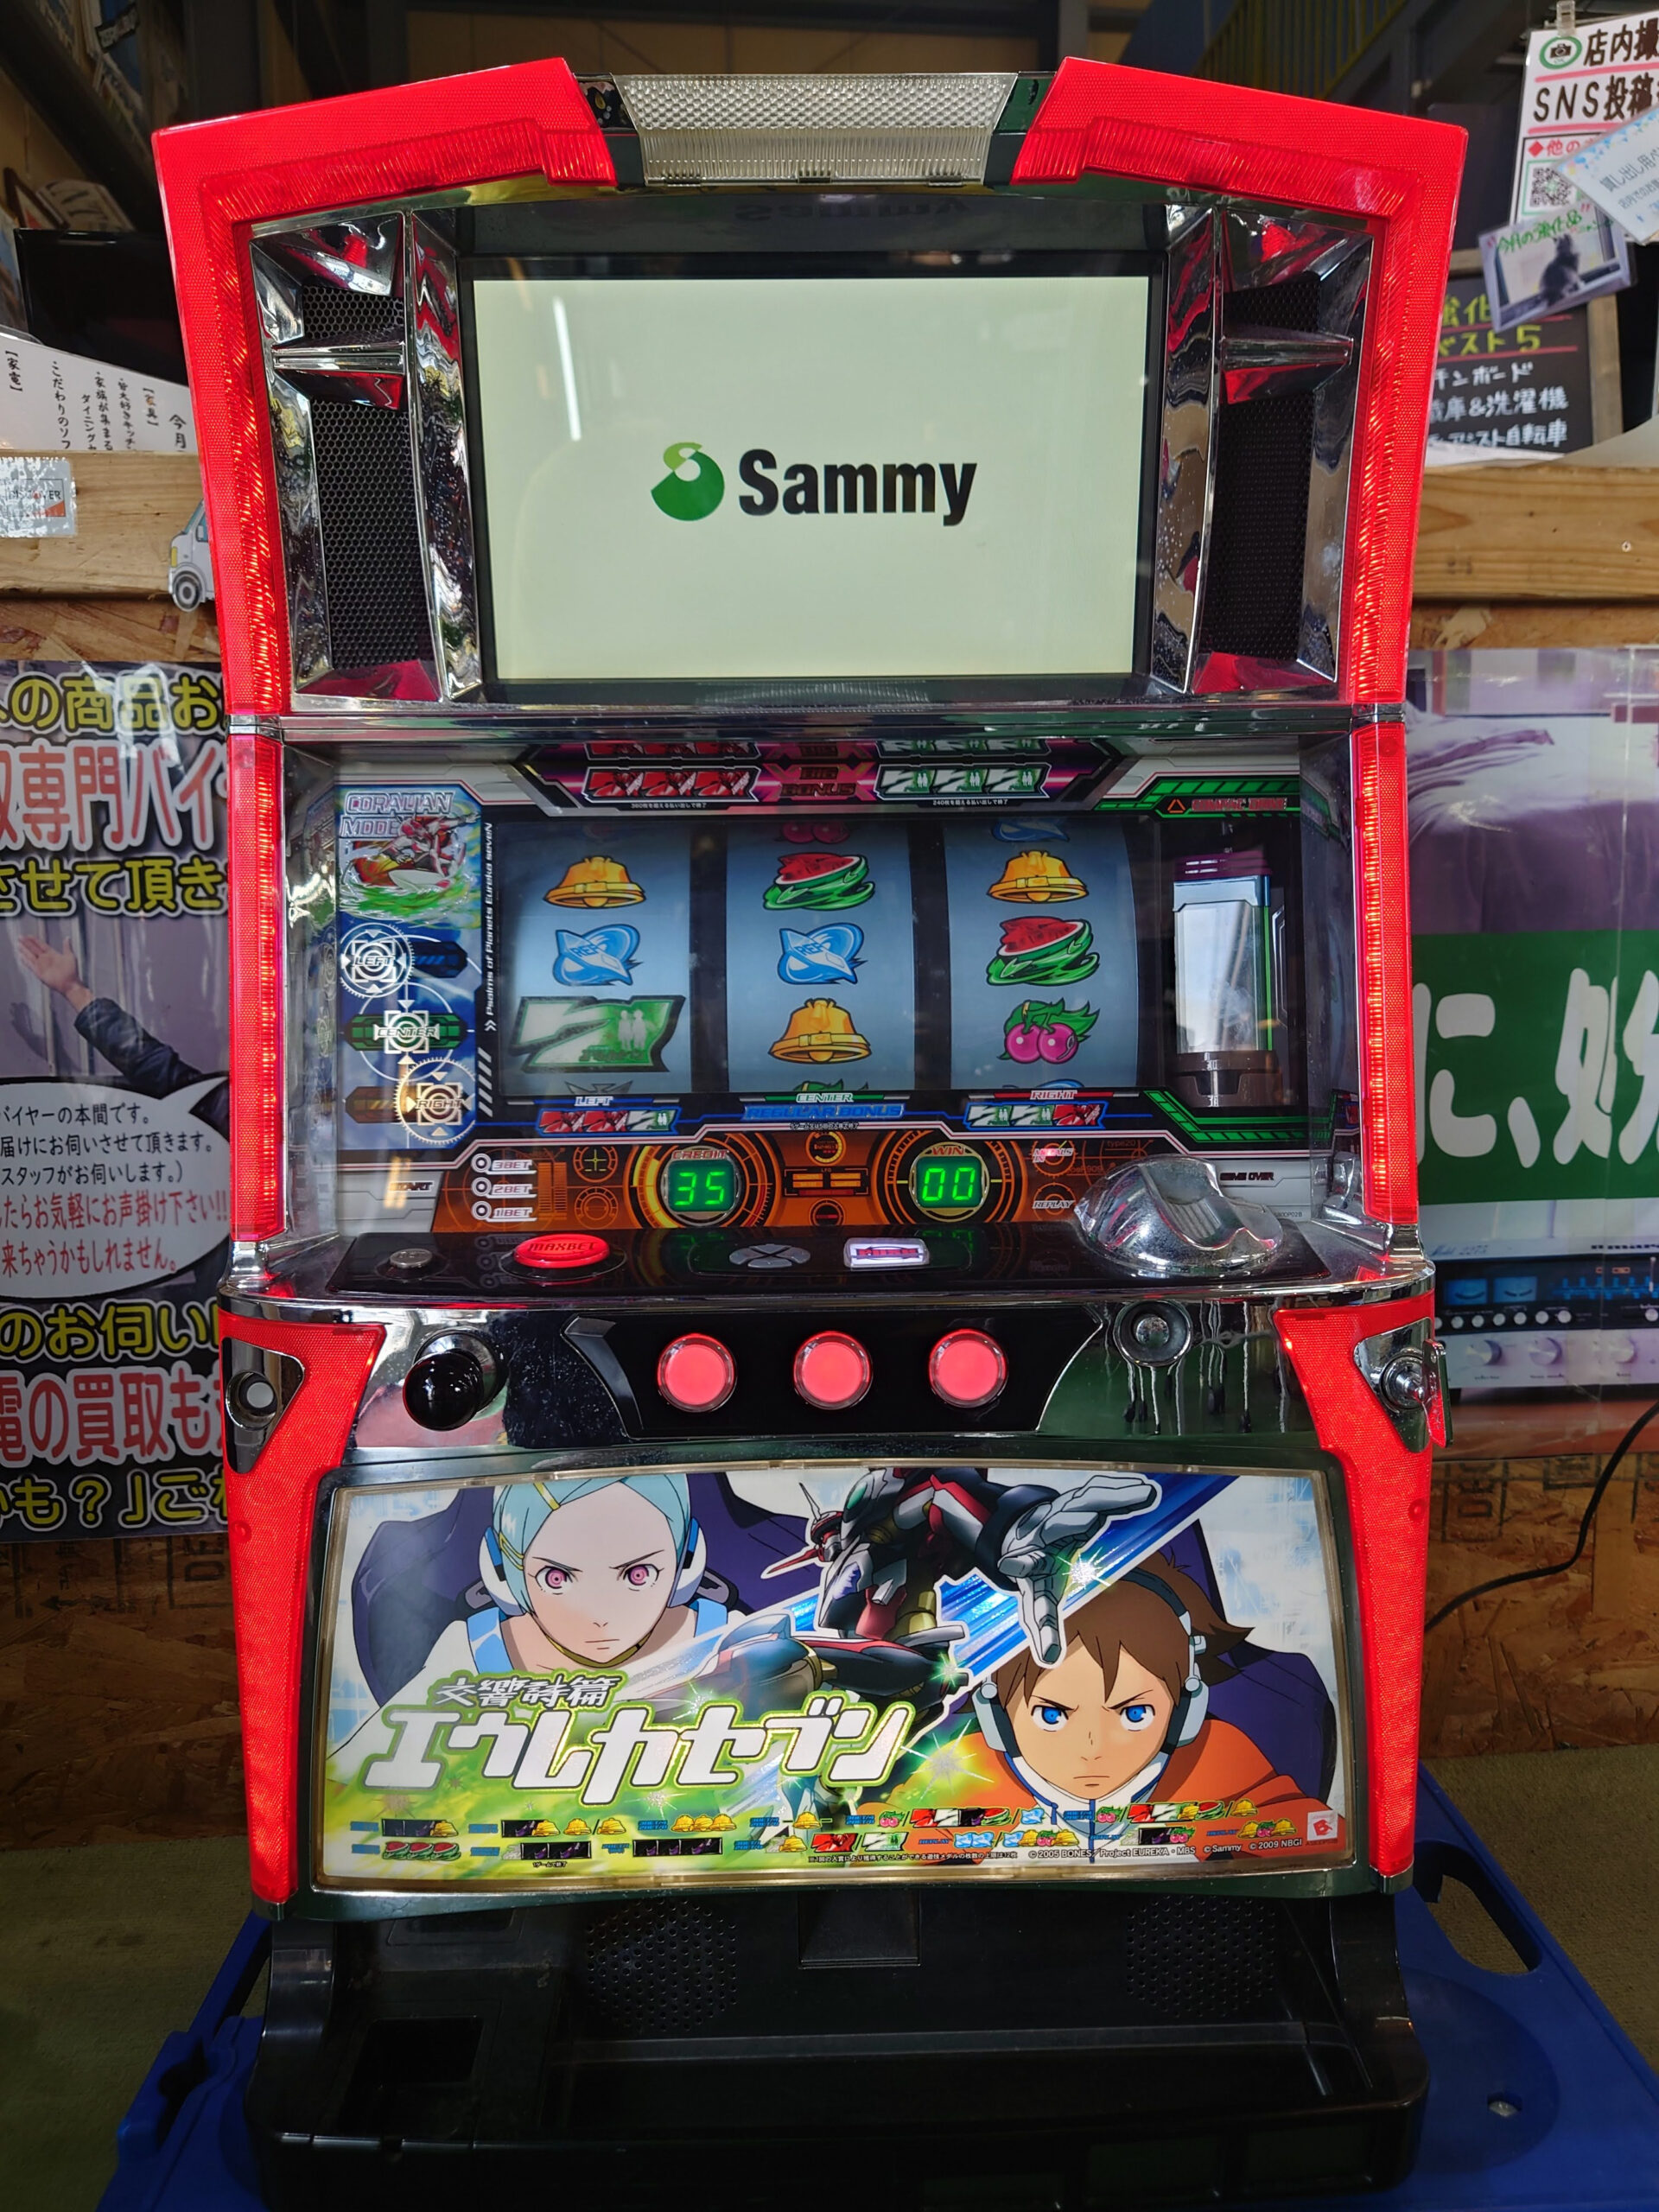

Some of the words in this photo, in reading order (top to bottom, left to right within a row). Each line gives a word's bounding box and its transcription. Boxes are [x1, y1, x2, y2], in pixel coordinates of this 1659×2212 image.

[738, 448, 977, 527] Sammy
[0, 671, 223, 732] の商品お
[0, 743, 226, 845] 専門バイ
[353, 955, 395, 967] LEFT
[377, 1027, 436, 1038] CENTER
[796, 1093, 854, 1103] CENTER
[1031, 1090, 1077, 1100] RIGHT
[416, 1098, 461, 1109] RIGHT
[575, 1096, 613, 1107] LEFT
[745, 1105, 836, 1119] REGULAR
[837, 1104, 904, 1117] BONUS
[671, 1149, 729, 1160] CREDIT
[931, 1145, 966, 1156] WIN
[494, 1160, 531, 1170] 3BET
[493, 1185, 531, 1195] 2BET
[674, 1171, 726, 1206] 35
[921, 1167, 976, 1202] 00
[1032, 1200, 1076, 1210] REPLAY
[527, 1242, 599, 1252] MAXBET
[2, 1304, 219, 1361] のお伺い
[0, 1366, 222, 1465] 電の買取も
[435, 1675, 620, 1709] 交響詩篇
[363, 1695, 914, 1807] エウレカセブン
[1258, 1840, 1280, 1850] 2009
[1281, 1838, 1303, 1848] NBGI
[1038, 1849, 1059, 1859] 2005
